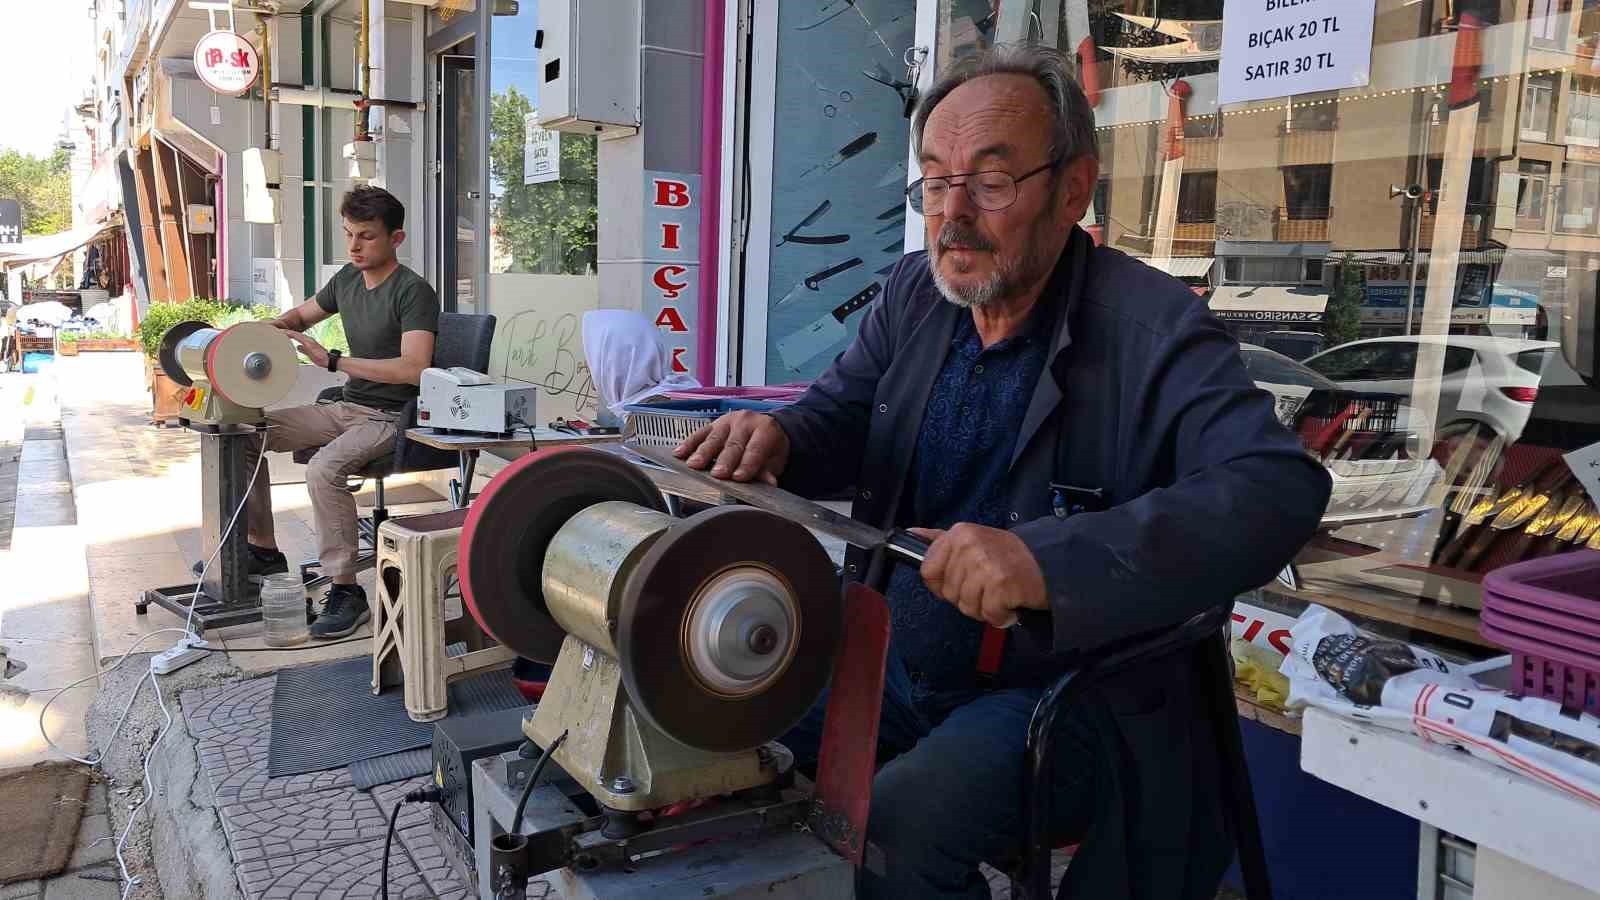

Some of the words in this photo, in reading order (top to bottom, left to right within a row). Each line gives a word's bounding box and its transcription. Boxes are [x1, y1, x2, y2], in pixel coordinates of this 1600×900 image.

[1248, 25, 1295, 48] BIÇAK
[1299, 21, 1317, 40] 20
[1322, 16, 1340, 32] TL
[1245, 60, 1289, 81] SATIR
[1294, 56, 1312, 74] 30
[1317, 52, 1335, 69] TL
